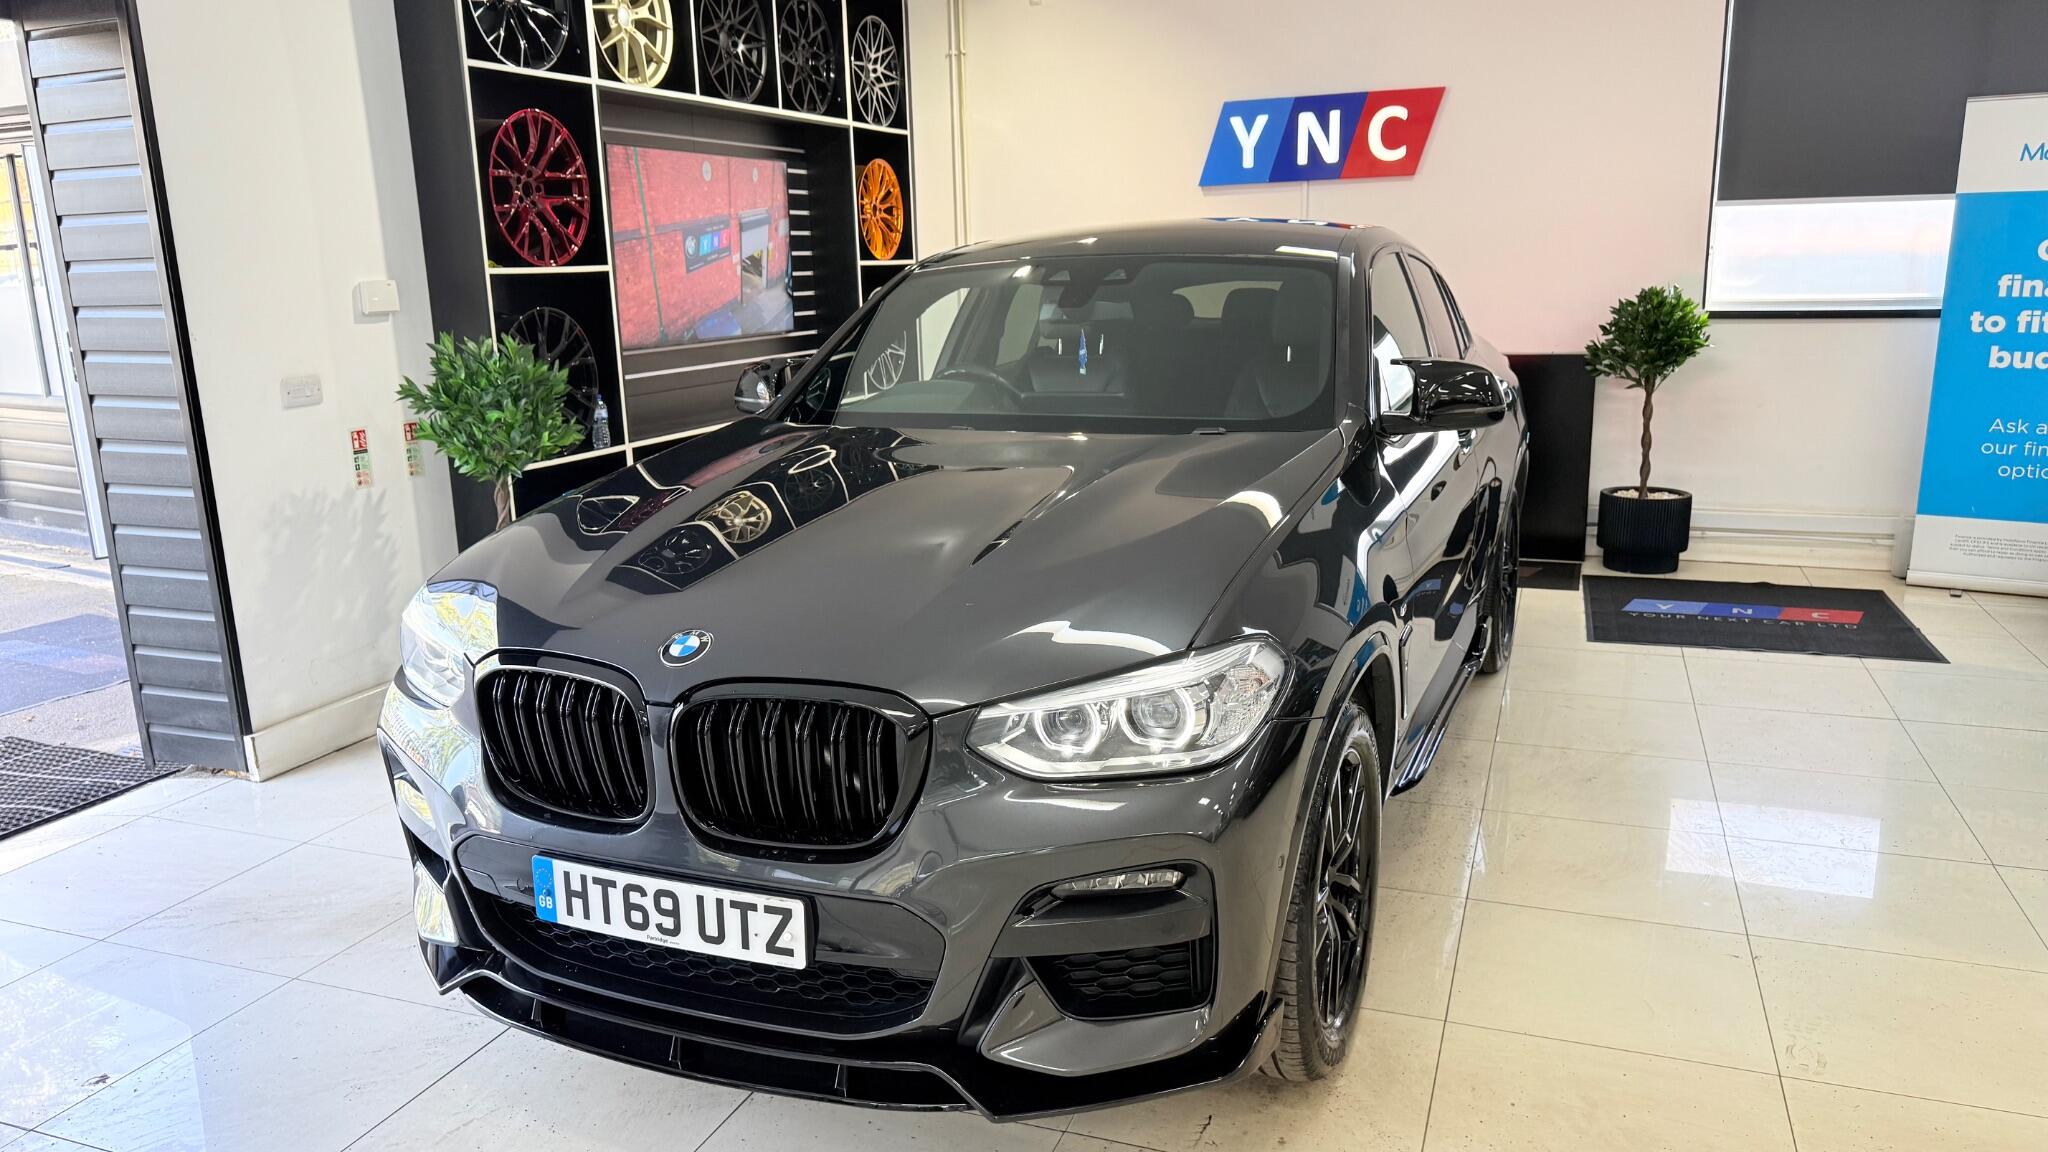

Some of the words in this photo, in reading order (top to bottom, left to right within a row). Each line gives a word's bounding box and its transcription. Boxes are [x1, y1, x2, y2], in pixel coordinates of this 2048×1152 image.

[1970, 311, 2006, 333] to
[1988, 418, 2030, 434] Ask
[1981, 442, 2018, 456] our
[1628, 612, 1686, 620] YOUR
[1697, 614, 1752, 623] NEXT
[538, 894, 553, 909] GB
[563, 870, 682, 938] HT69
[696, 894, 795, 957] UTZ
